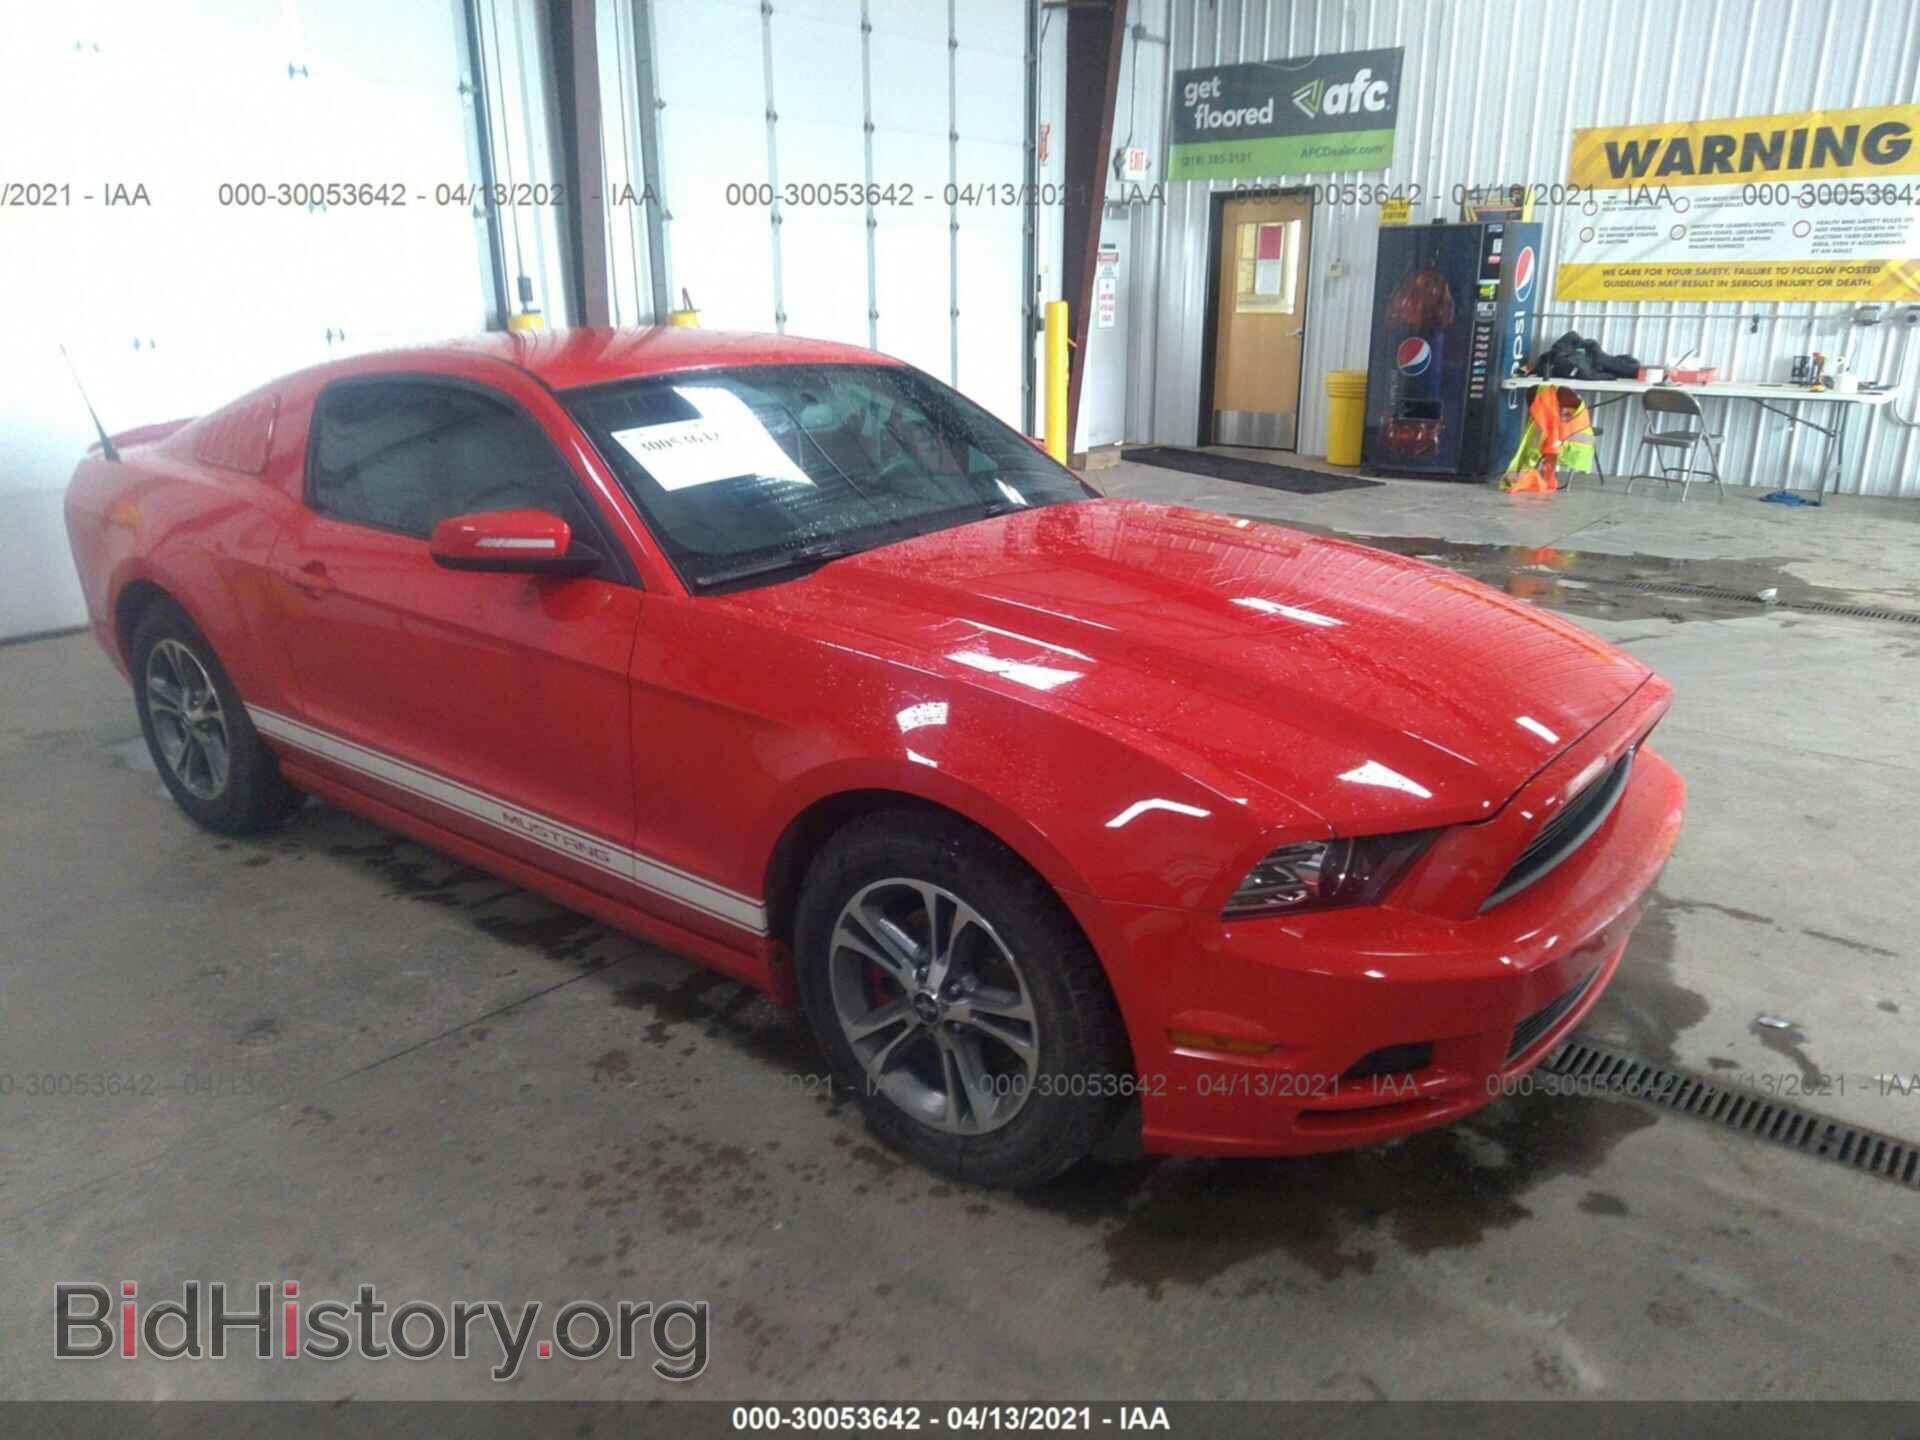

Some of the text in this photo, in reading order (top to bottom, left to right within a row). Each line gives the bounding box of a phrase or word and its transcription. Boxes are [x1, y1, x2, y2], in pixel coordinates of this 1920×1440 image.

[1184, 76, 1222, 107] get
[1322, 68, 1390, 116] afc
[1194, 98, 1274, 130] floored
[1604, 121, 1913, 179] WARNING
[1602, 267, 1616, 276] WE
[1618, 268, 1642, 276] CARE
[1645, 267, 1663, 276] FOR
[1667, 267, 1691, 276] YOUR
[1734, 266, 1773, 276] FAILURE
[1776, 266, 1789, 275] TO
[1792, 266, 1837, 275] FOLLOW
[1839, 265, 1881, 275] POSTED
[1603, 279, 1657, 288] GUIDELINES
[1657, 279, 1681, 288] MAY
[1682, 279, 1714, 288] RESULT
[1717, 279, 1729, 287] IN
[1731, 279, 1773, 288] SERIOUS
[1776, 278, 1813, 287] INJURY
[1817, 278, 1833, 287] OR
[502, 811, 610, 863] MUSTANG
